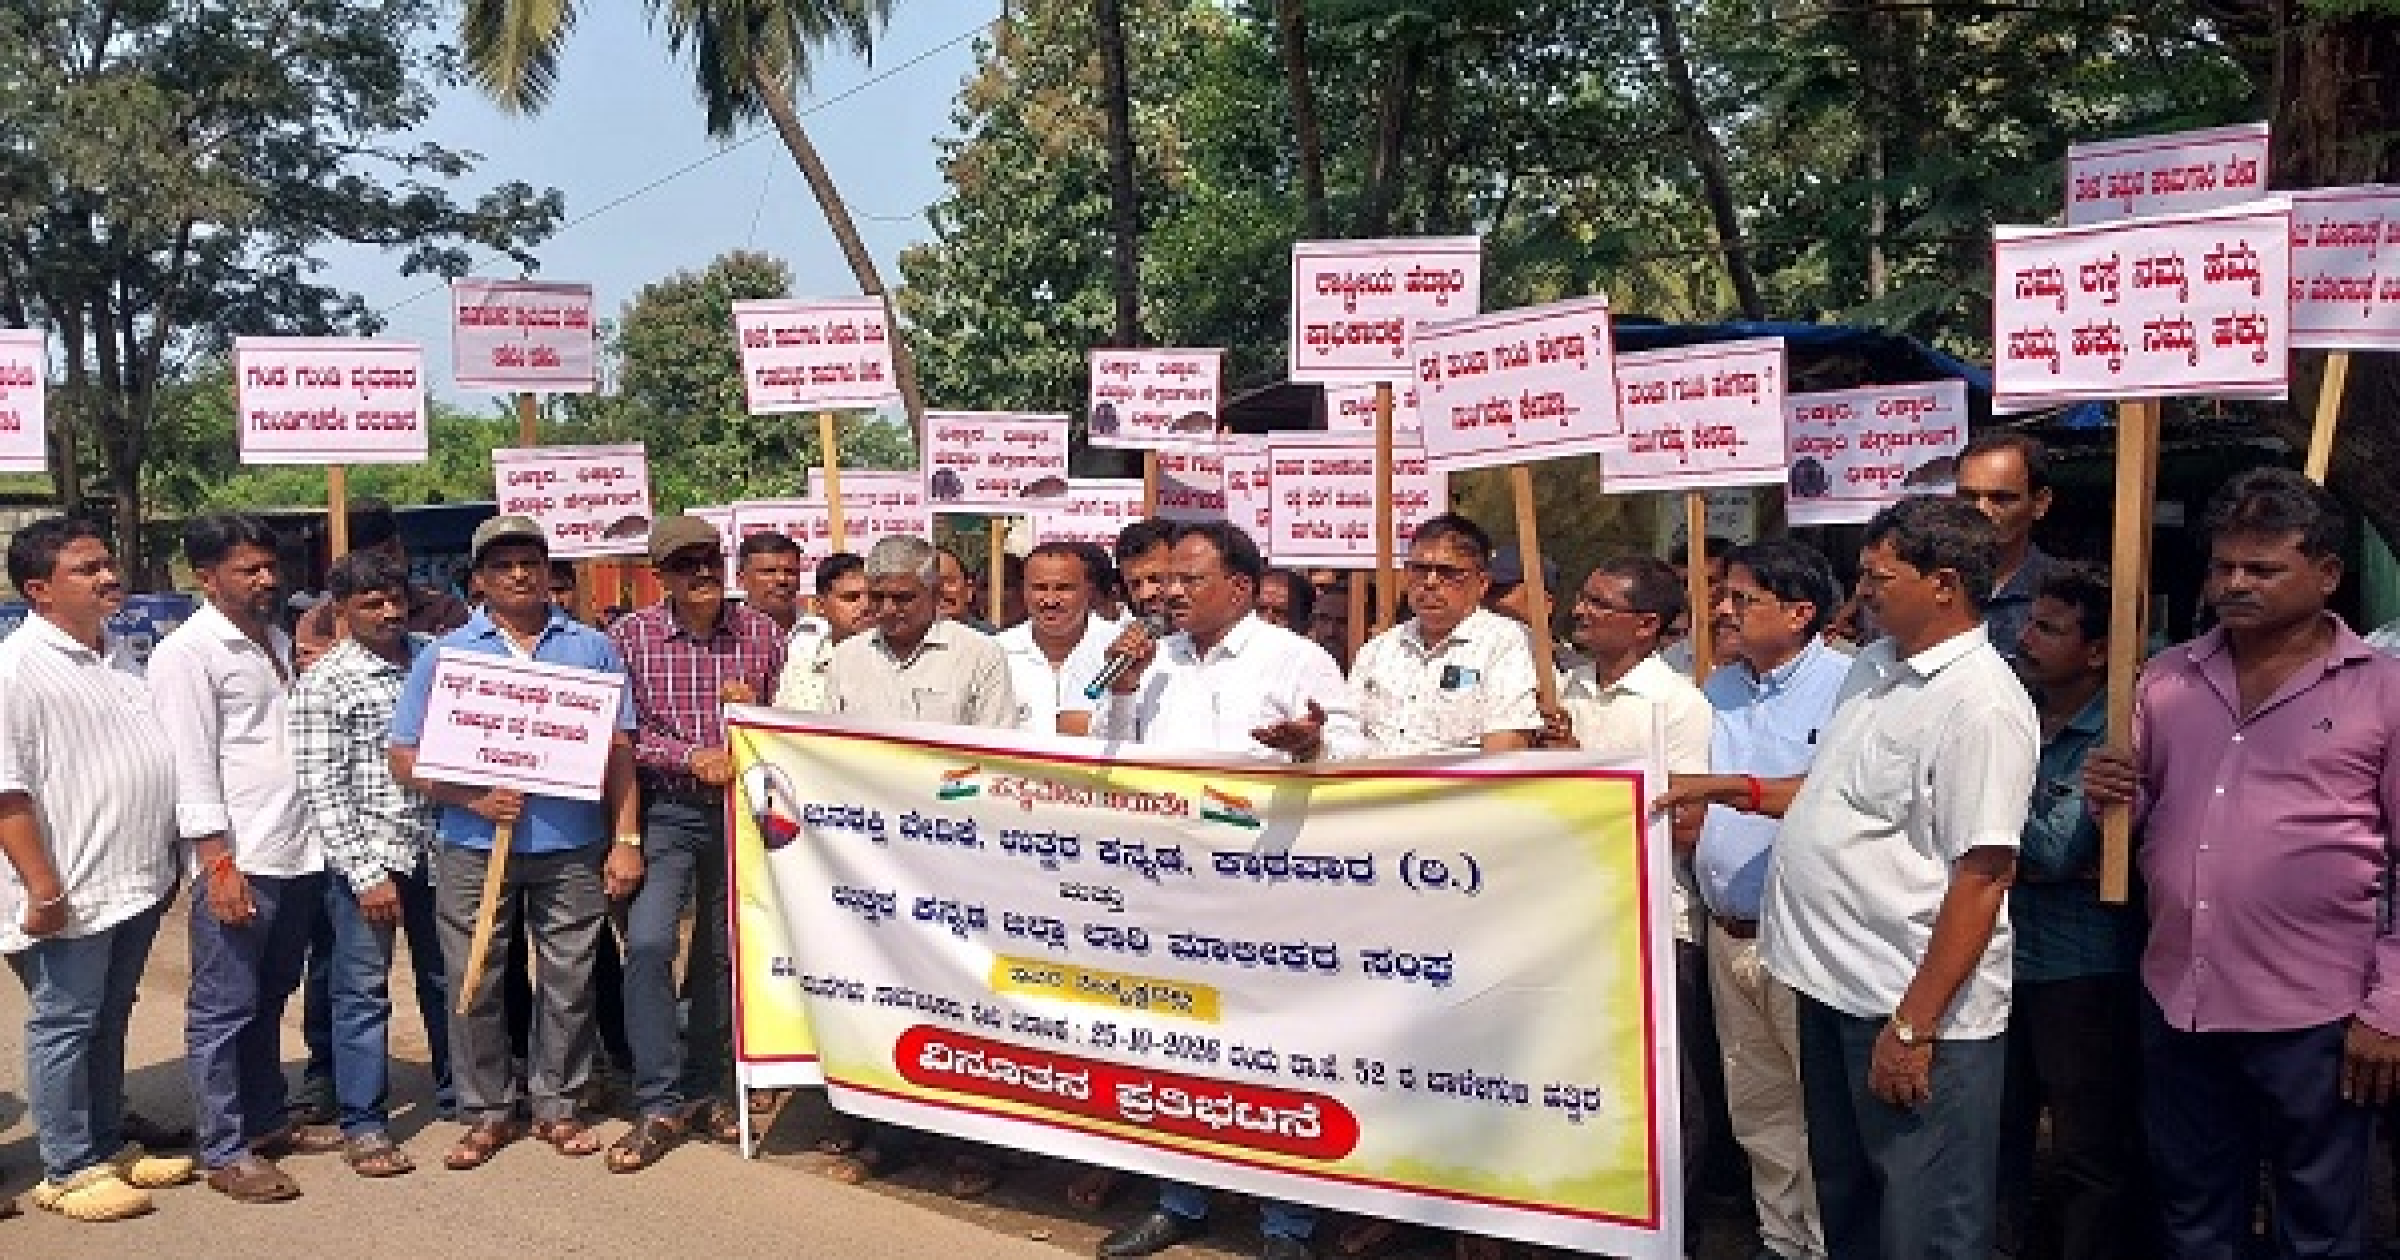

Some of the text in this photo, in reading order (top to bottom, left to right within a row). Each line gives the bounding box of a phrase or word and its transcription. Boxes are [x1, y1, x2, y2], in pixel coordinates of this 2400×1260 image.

[1315, 264, 1465, 310] ರಾಷ್ಟ್ರೀಯ ಹೆದ್ದಾರಿ
[2015, 261, 2066, 312] ನಮ್ಮ
[2080, 250, 2121, 305] ರಸ್ತೆ
[2133, 250, 2188, 303] ನಮ್ಮ
[2204, 240, 2261, 296] ಹೆಮ್ಮೆ
[1494, 340, 1529, 370] ಗುಂಡಿ
[2009, 323, 2060, 375] ನಮ್ಮ
[2144, 313, 2197, 367] ನಮ್ಮ
[2213, 308, 2268, 365] ಹಕ್ಕು
[999, 825, 1082, 870] ಉತ್ತರ
[1212, 849, 1375, 887] ಕಾರವಾರ
[912, 891, 989, 941] ಕನ್ನಡ
[1084, 921, 1151, 954] ಲಾರಿ
[1168, 927, 1341, 973] ಮಾಲೀಕರ
[1360, 944, 1455, 988] ಸಂಘ
[918, 1040, 1325, 1143] ವಿನೂತನ ಪ್ರತಿಭಟನೆ
[1354, 1059, 1385, 1086] 52
